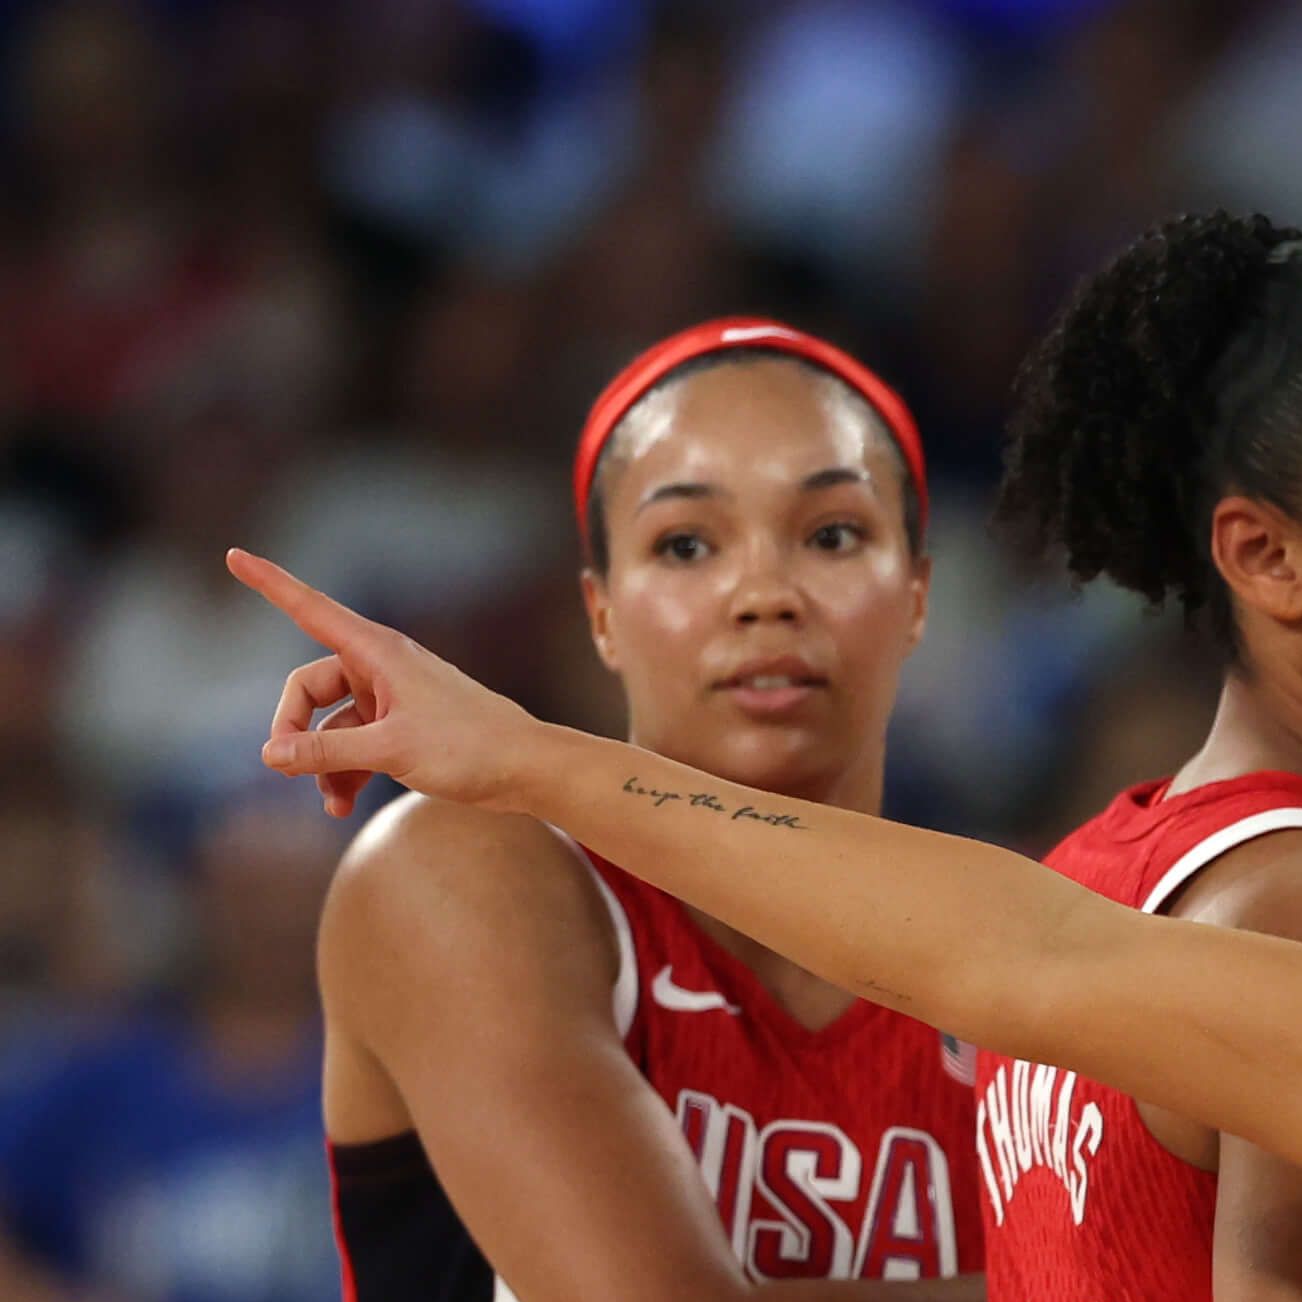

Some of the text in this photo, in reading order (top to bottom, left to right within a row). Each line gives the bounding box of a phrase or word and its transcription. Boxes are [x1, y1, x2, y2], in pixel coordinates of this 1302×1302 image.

[622, 776, 808, 830] keep the faith
[677, 1088, 958, 1282] USA
